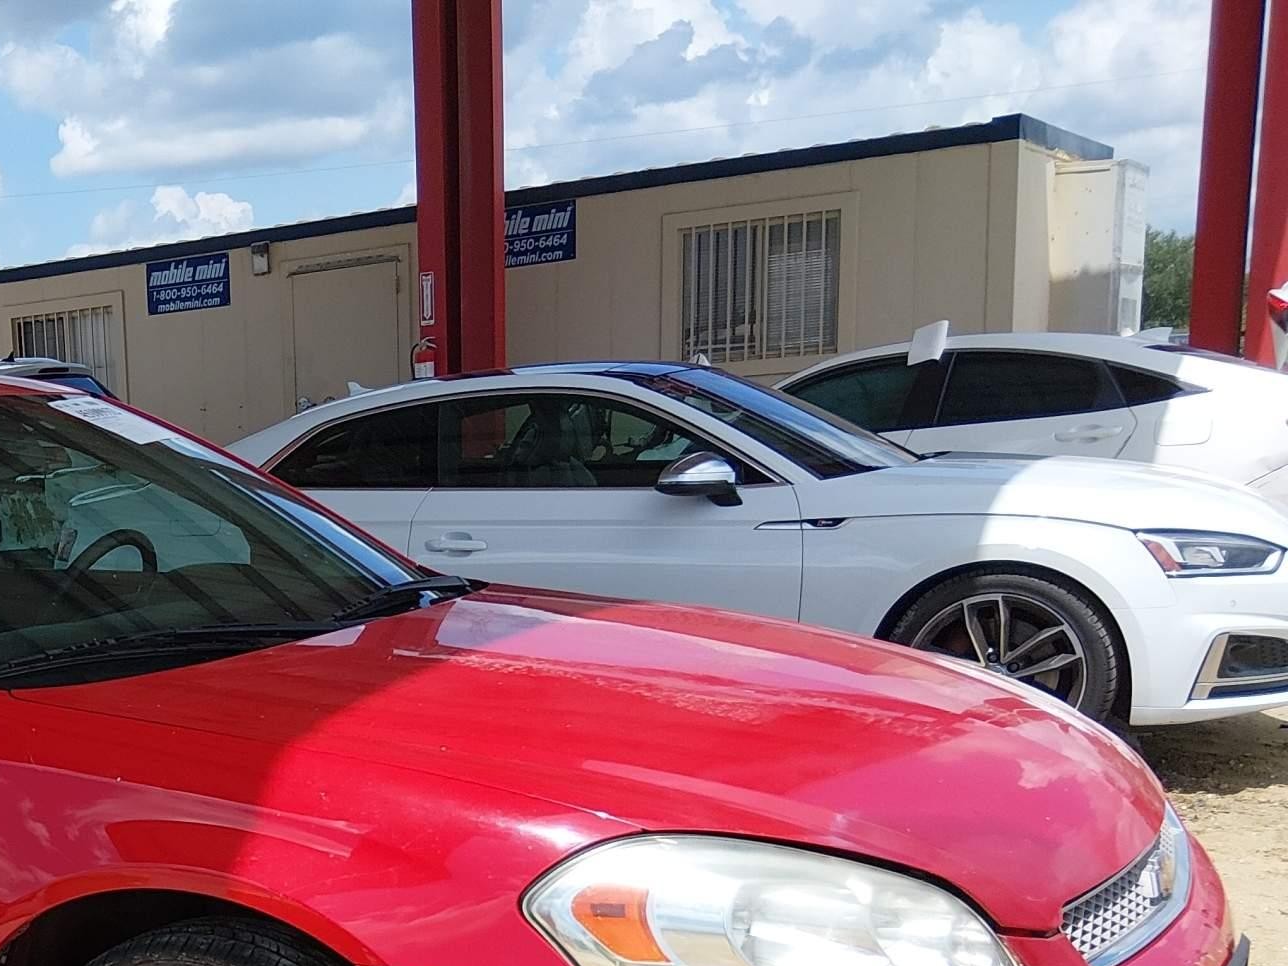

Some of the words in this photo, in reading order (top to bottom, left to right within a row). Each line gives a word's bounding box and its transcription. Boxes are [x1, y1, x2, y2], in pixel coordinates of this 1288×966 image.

[532, 207, 572, 232] mini
[149, 260, 194, 286] mobile
[195, 258, 227, 281] mini
[153, 282, 224, 301] 1-800-950-6464
[157, 297, 220, 313] mobilemini.com
